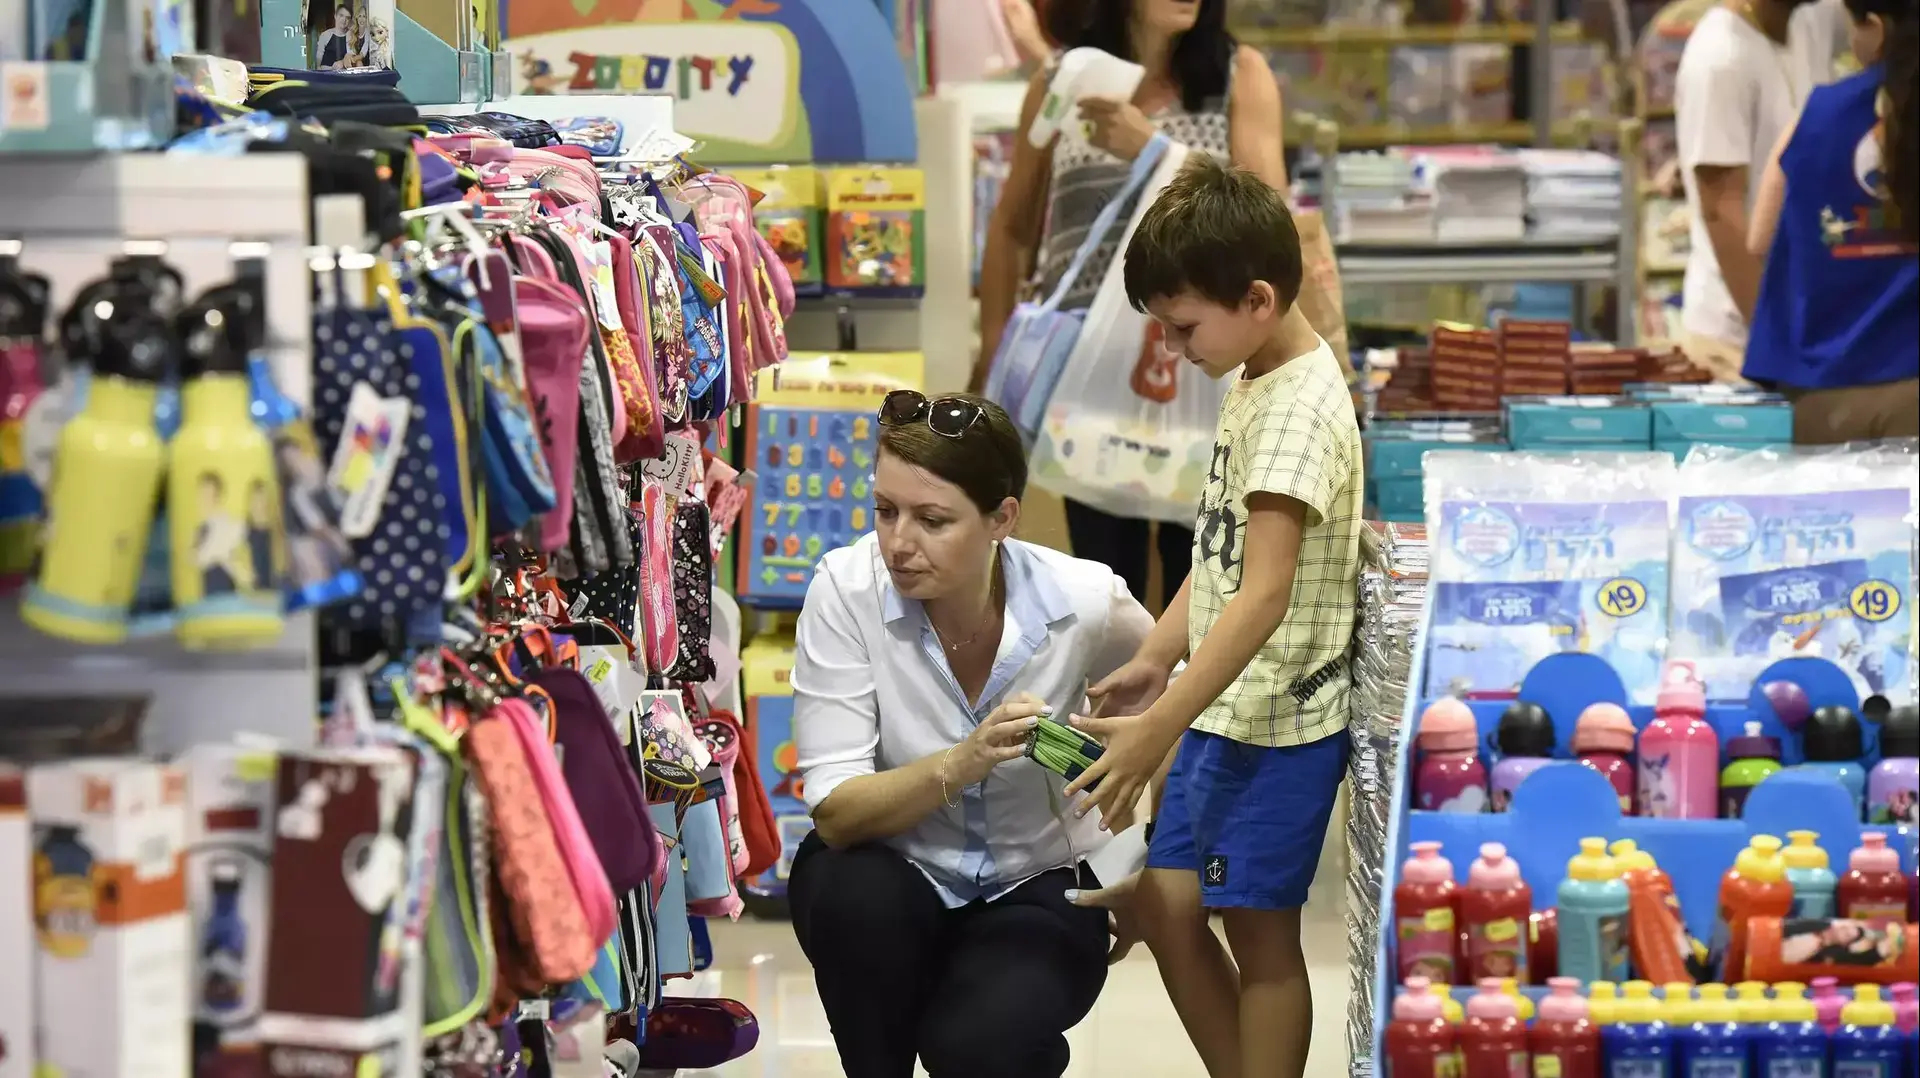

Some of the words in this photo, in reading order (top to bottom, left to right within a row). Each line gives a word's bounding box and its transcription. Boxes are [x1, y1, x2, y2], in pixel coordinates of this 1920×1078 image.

[678, 54, 754, 100] עידן
[1607, 584, 1638, 612] 19
[1857, 588, 1890, 616] 19
